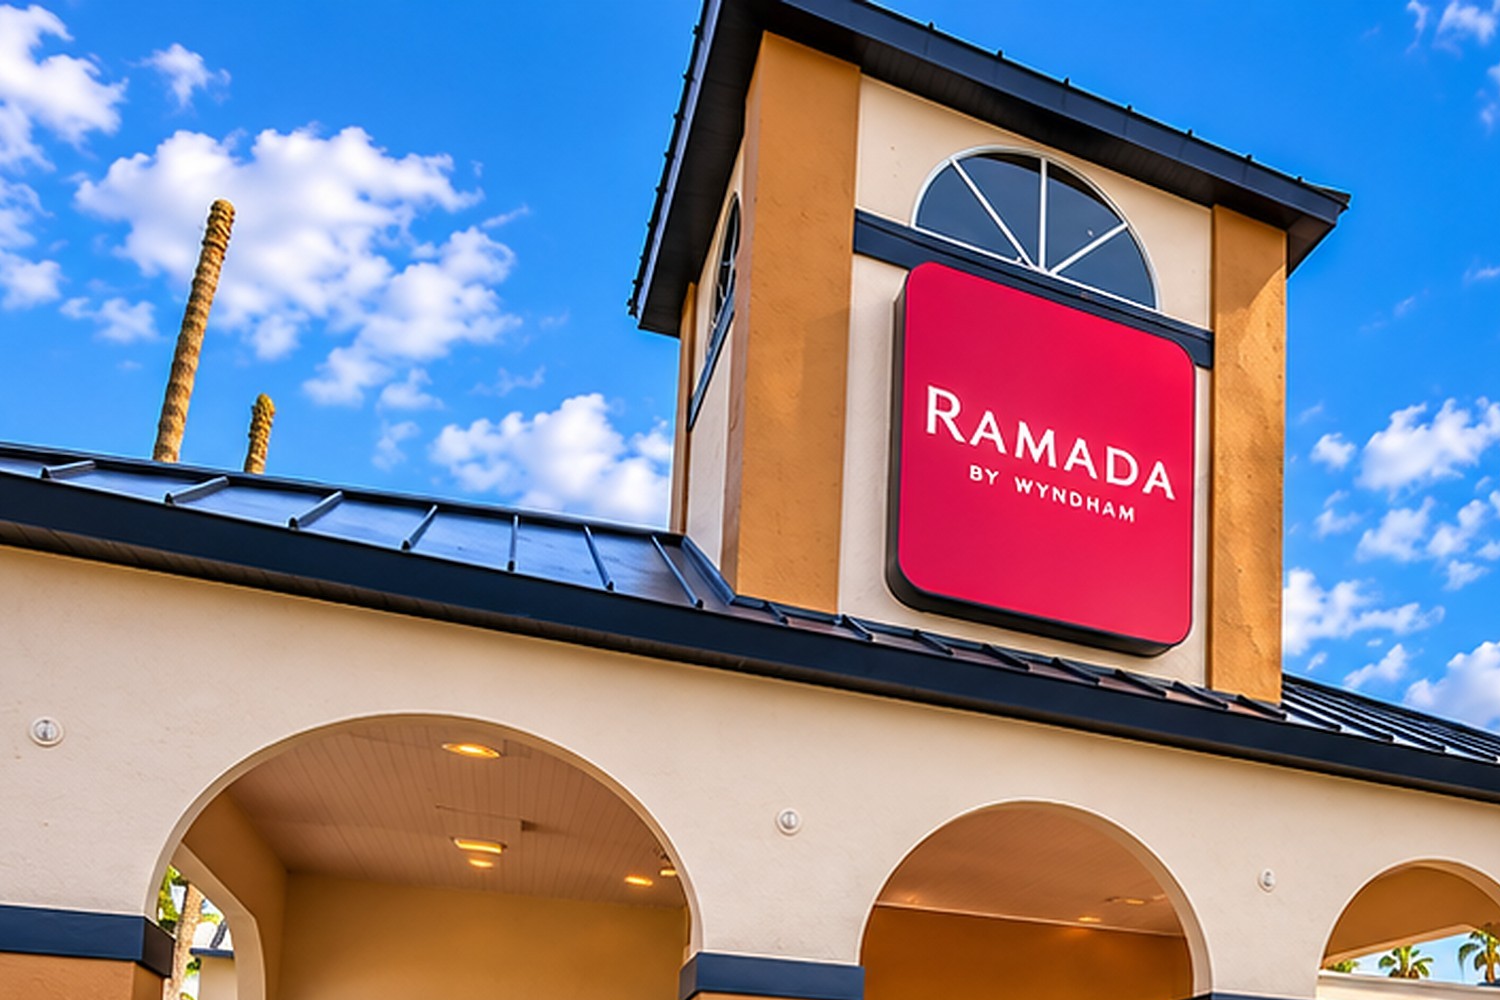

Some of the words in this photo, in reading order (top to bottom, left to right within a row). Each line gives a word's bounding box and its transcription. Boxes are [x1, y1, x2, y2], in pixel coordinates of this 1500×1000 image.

[926, 385, 1175, 500] RAMADA
[969, 464, 999, 485] BY
[1014, 476, 1135, 523] WYNDHAM
